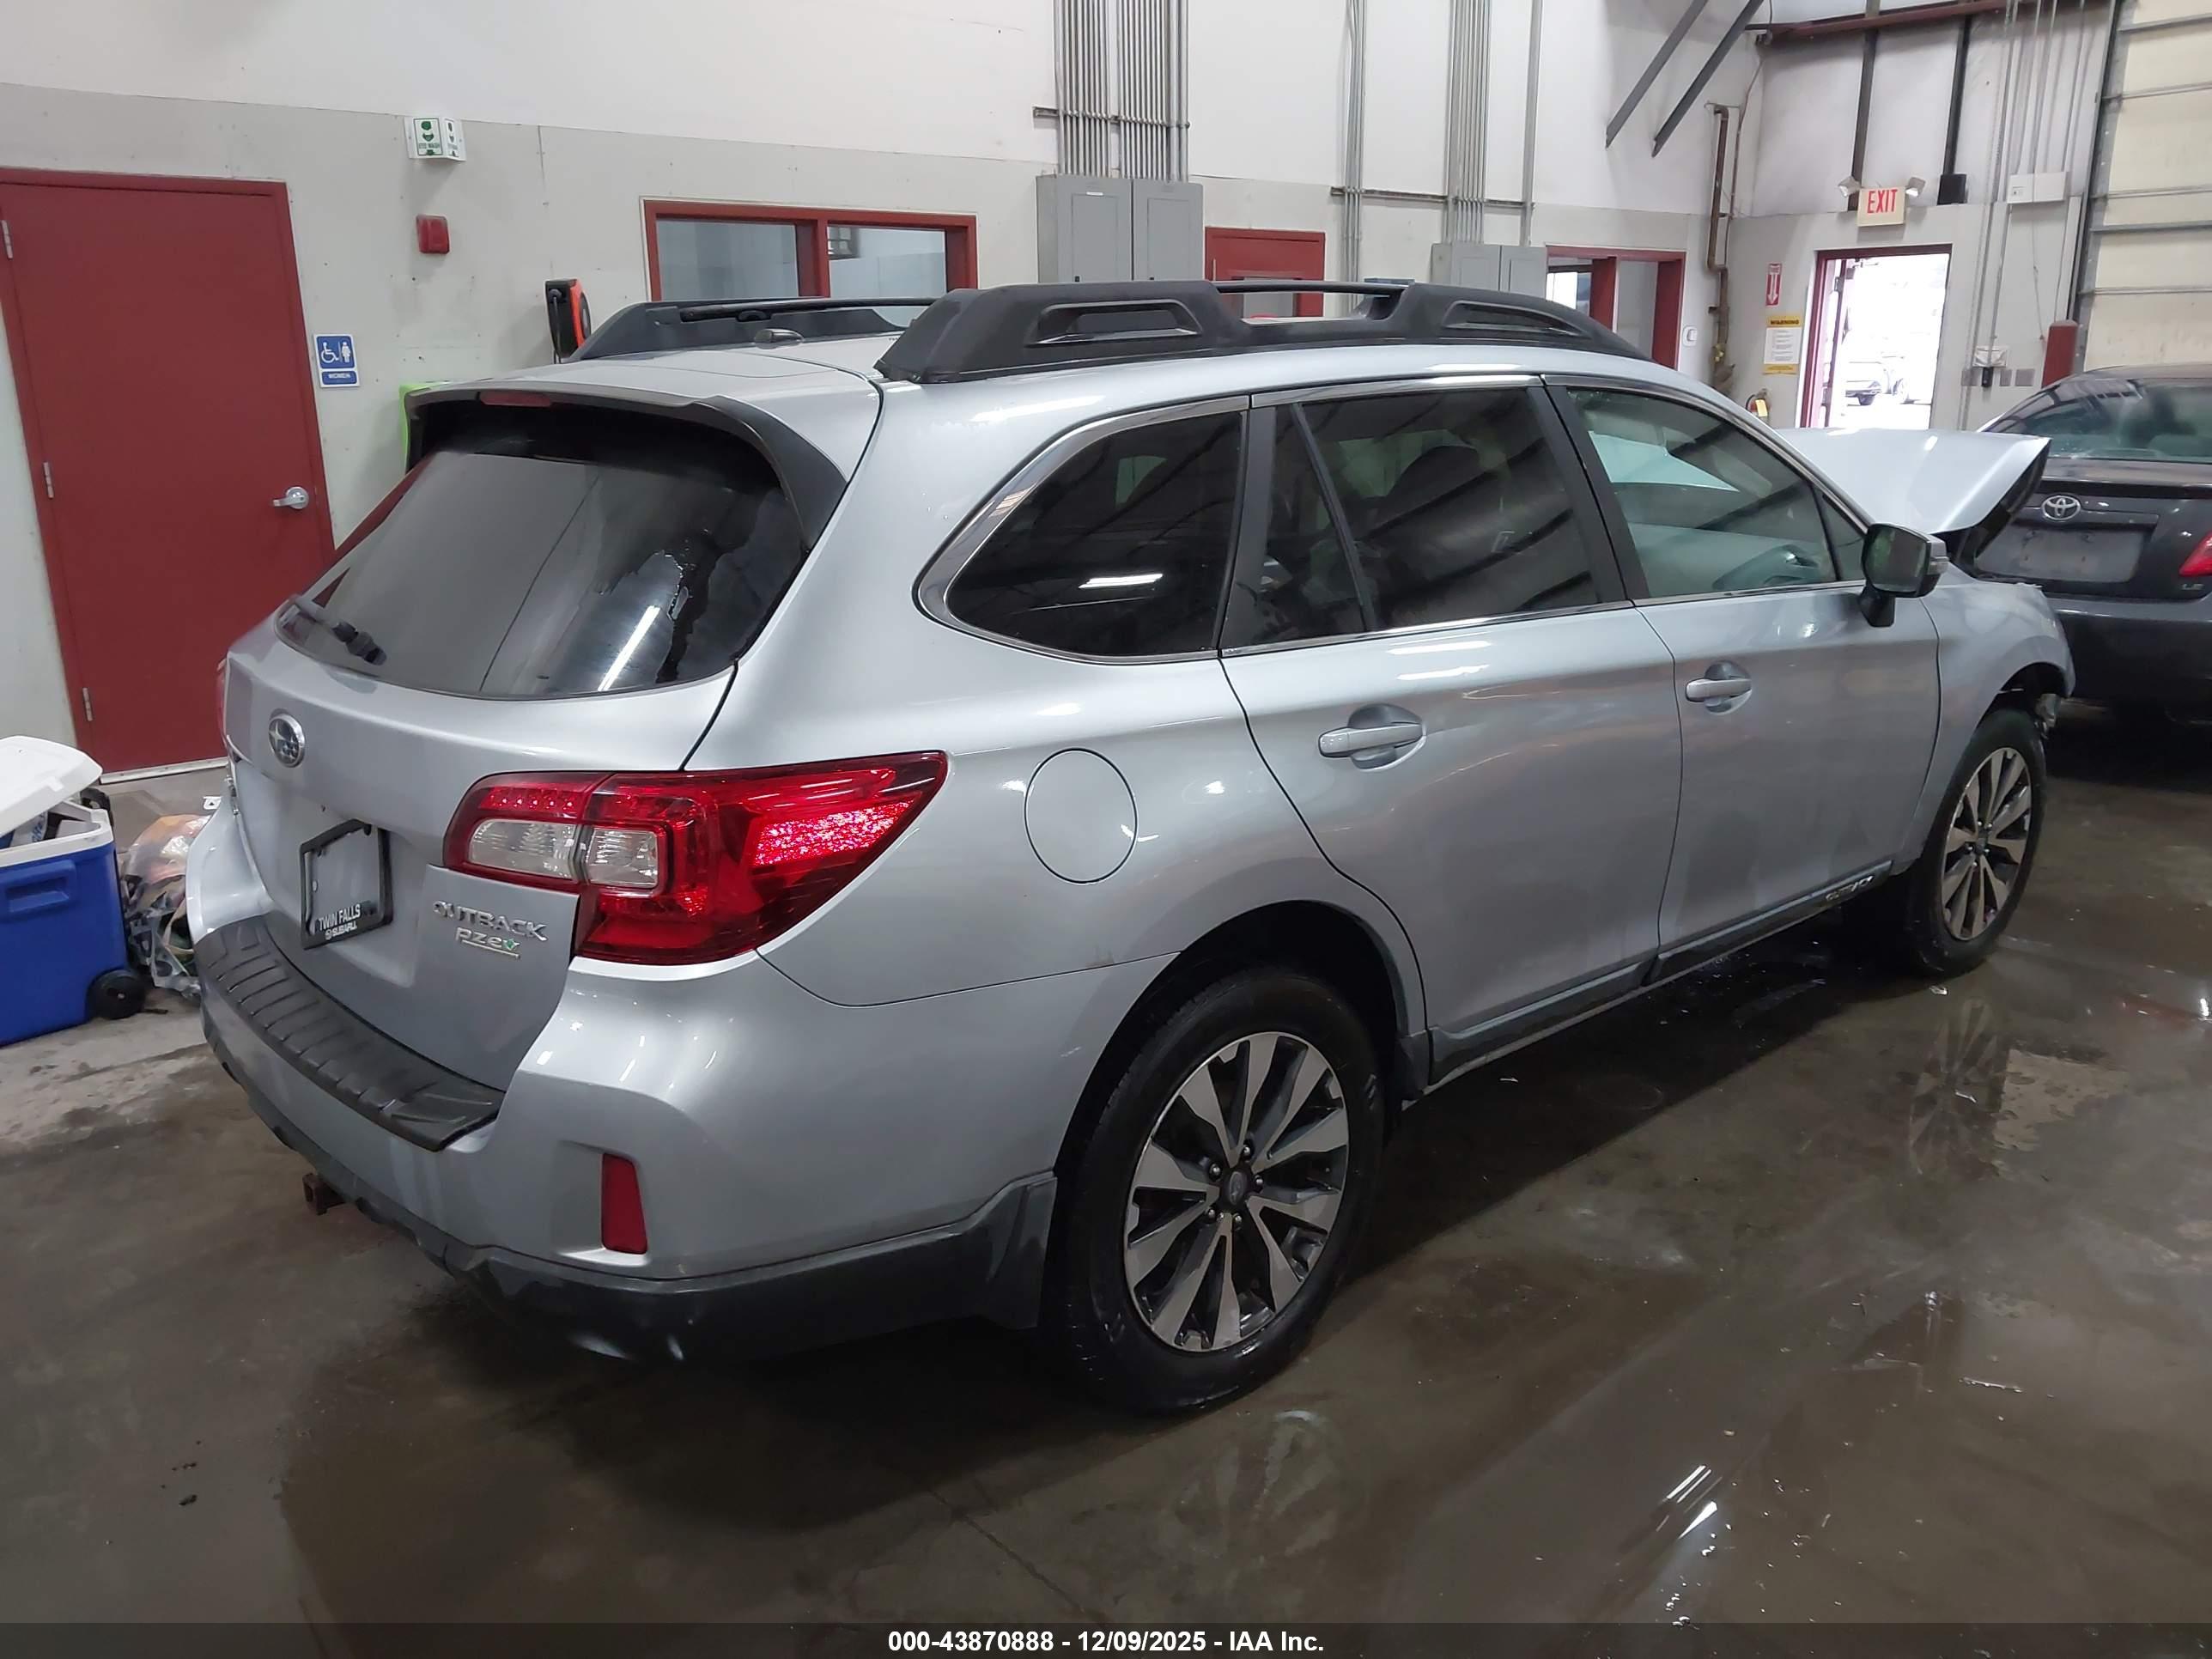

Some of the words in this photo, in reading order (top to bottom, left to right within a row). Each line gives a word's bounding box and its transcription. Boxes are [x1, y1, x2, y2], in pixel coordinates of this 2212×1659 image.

[1867, 188, 1898, 214] EXIT
[318, 910, 338, 932] TWIN
[338, 903, 361, 925] FALLS
[433, 899, 548, 942] OUTBACK
